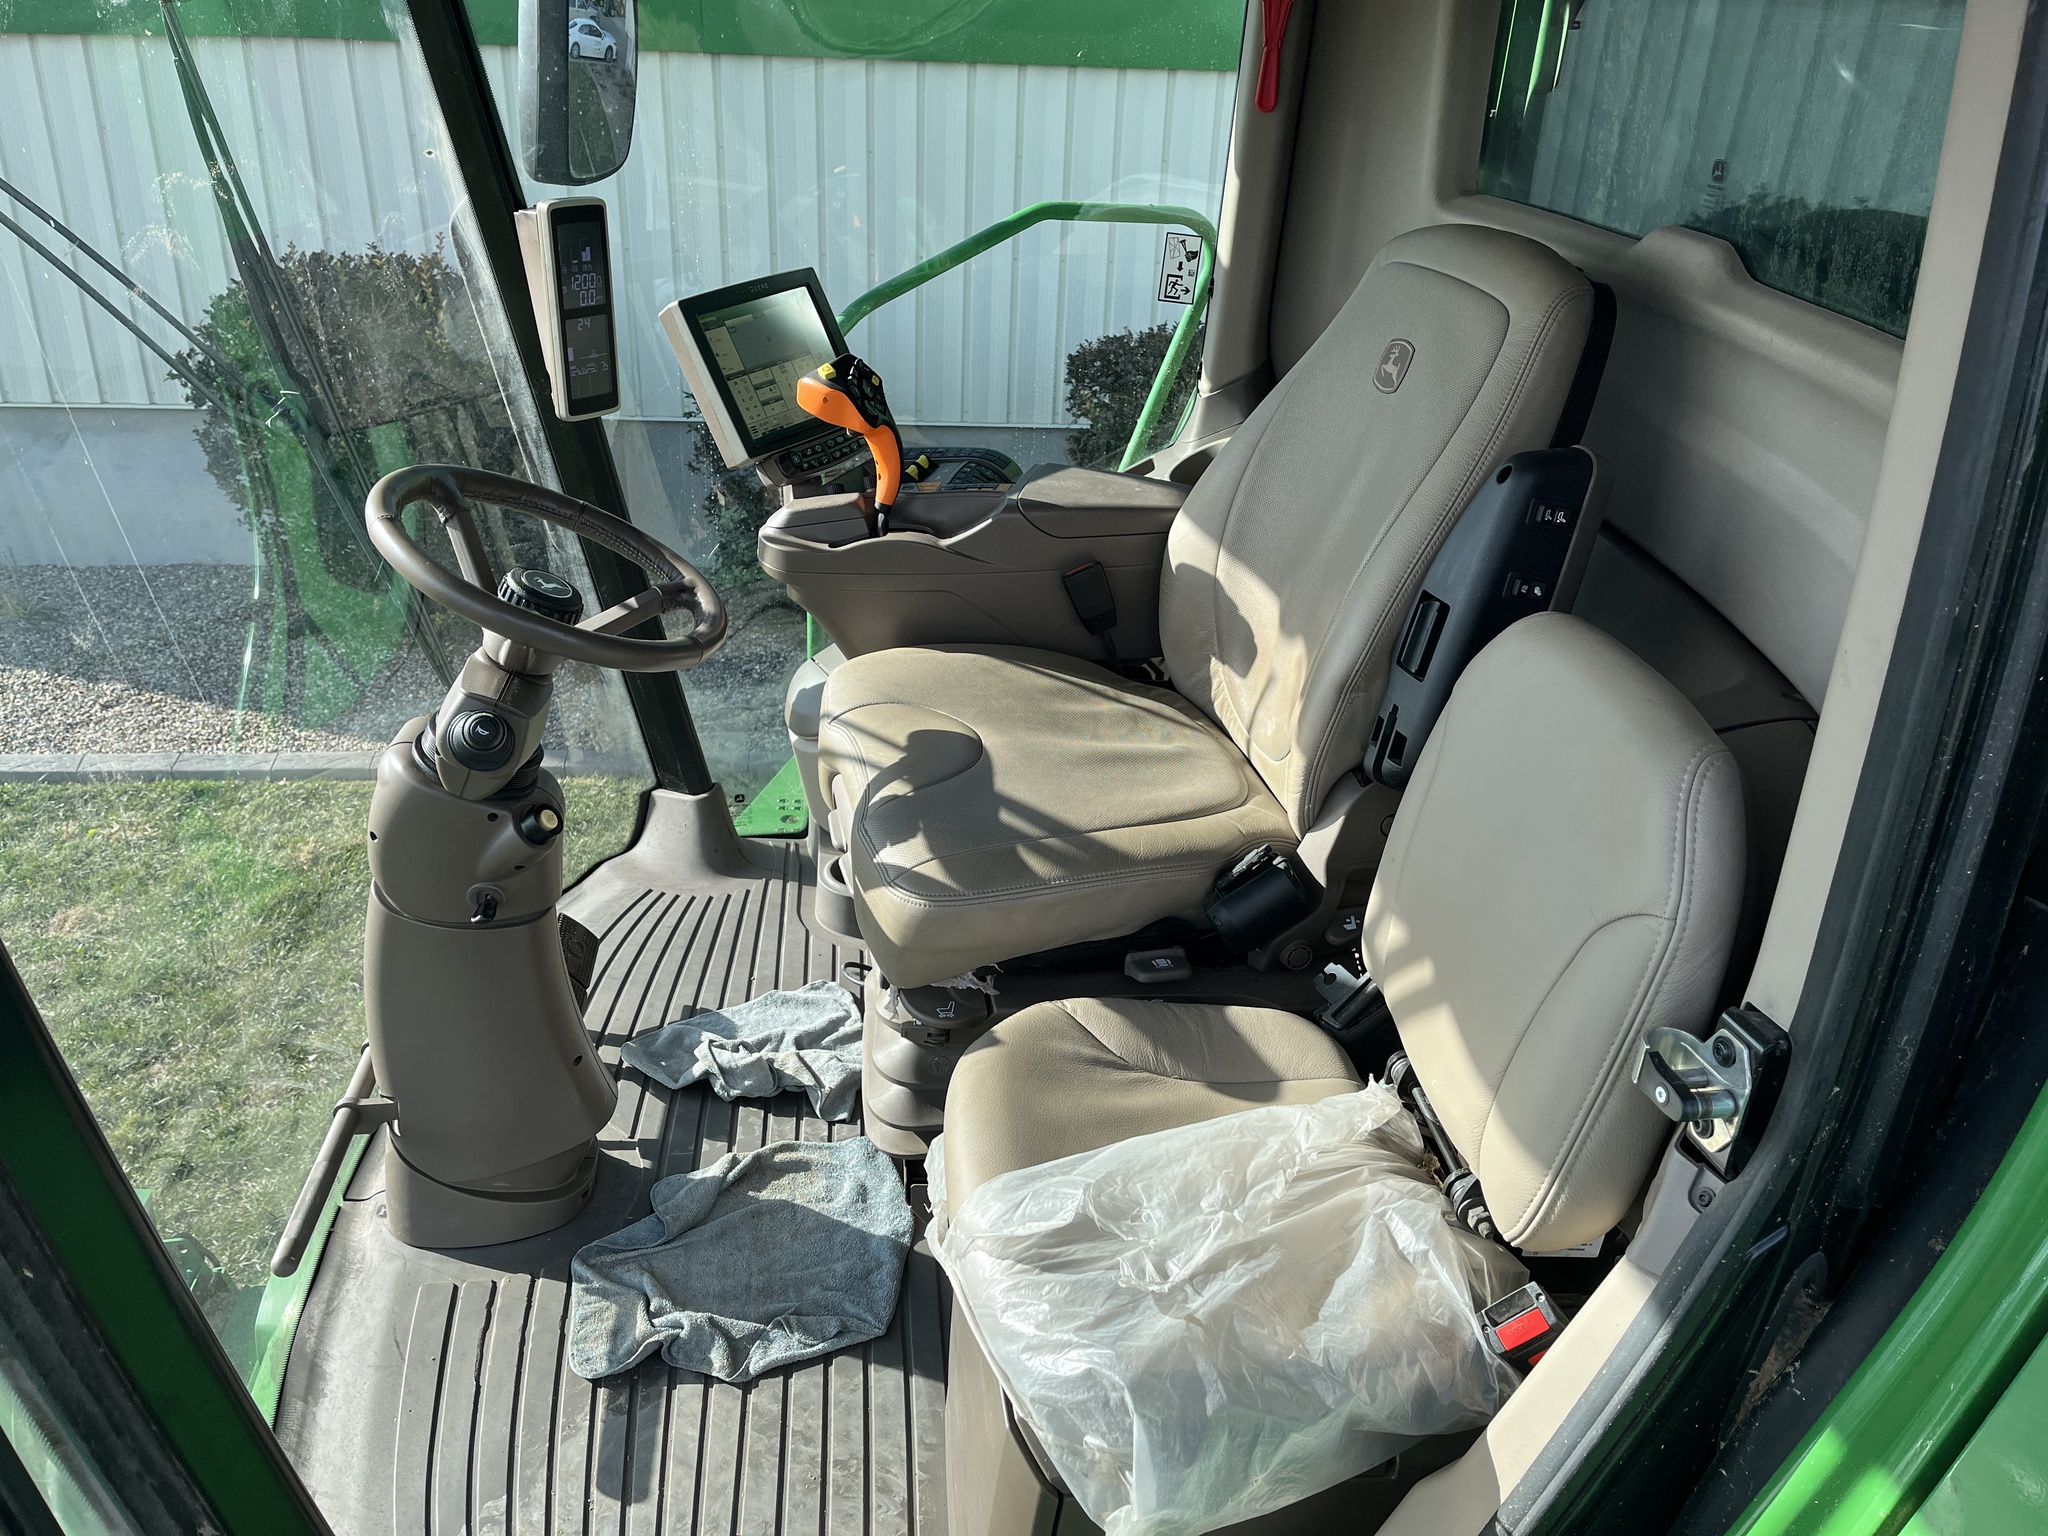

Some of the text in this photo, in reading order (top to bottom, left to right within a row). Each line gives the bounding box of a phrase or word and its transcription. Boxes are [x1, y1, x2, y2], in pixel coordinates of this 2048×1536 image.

[571, 272, 596, 290] 1200
[580, 289, 596, 306] 0.0
[578, 318, 591, 331] 24
